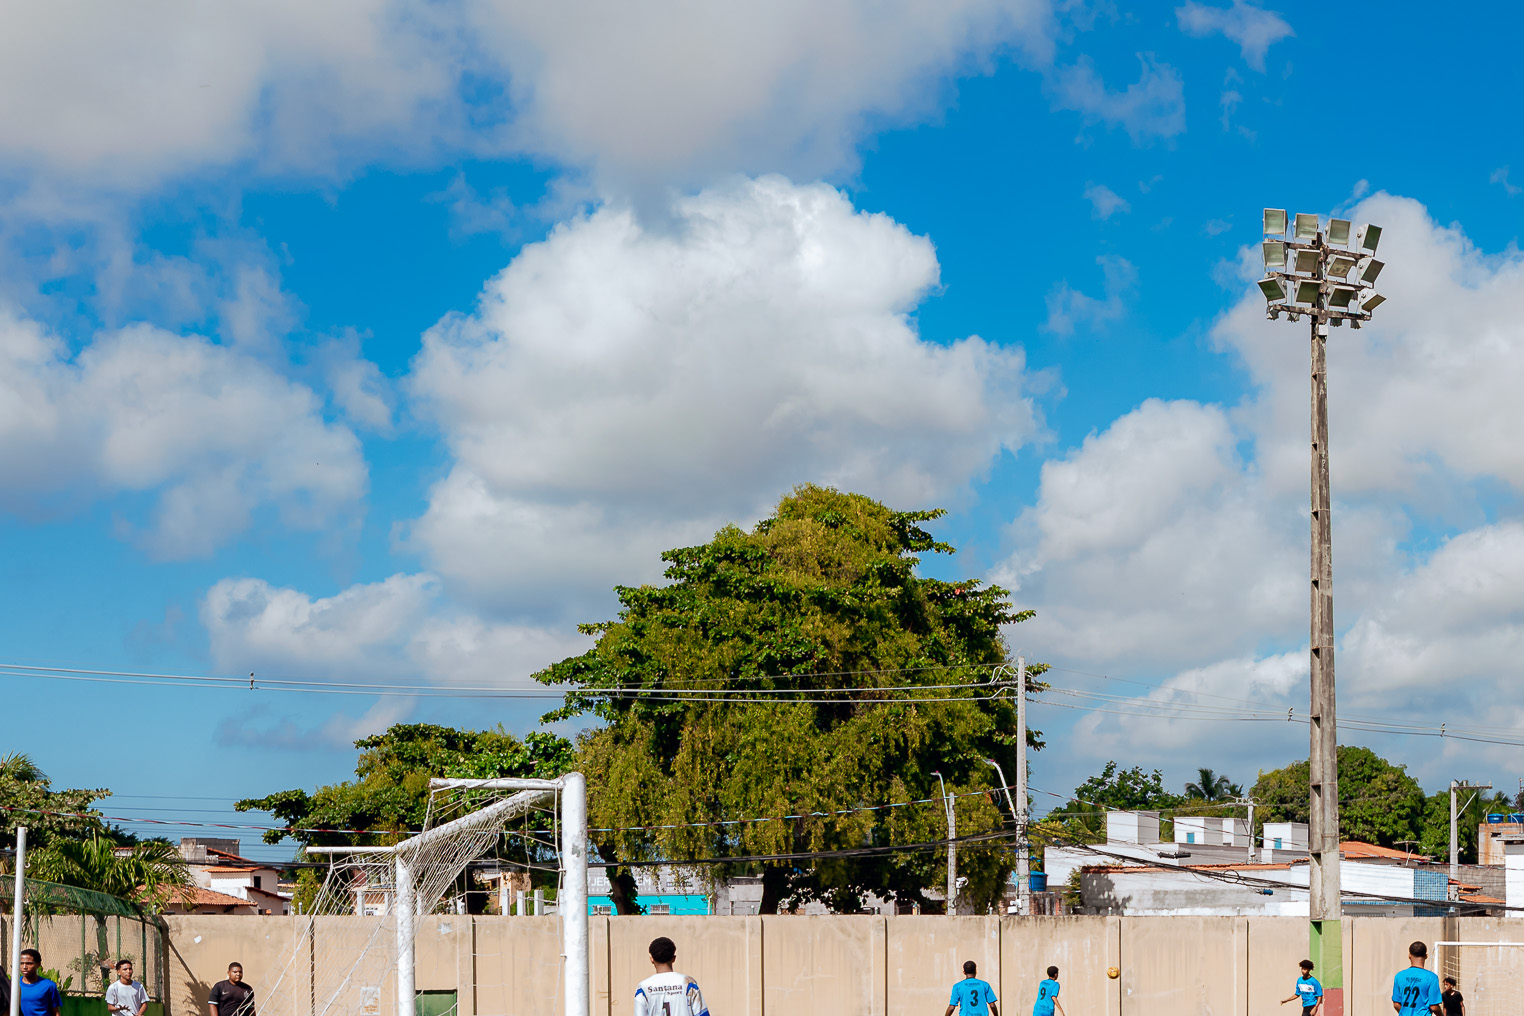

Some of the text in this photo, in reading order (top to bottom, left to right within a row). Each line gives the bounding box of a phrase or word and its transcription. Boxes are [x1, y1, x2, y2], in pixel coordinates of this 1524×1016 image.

[647, 984, 683, 993] Santana
[1040, 987, 1047, 1000] 9
[970, 989, 979, 1007] 3
[1403, 986, 1420, 1008] 22
